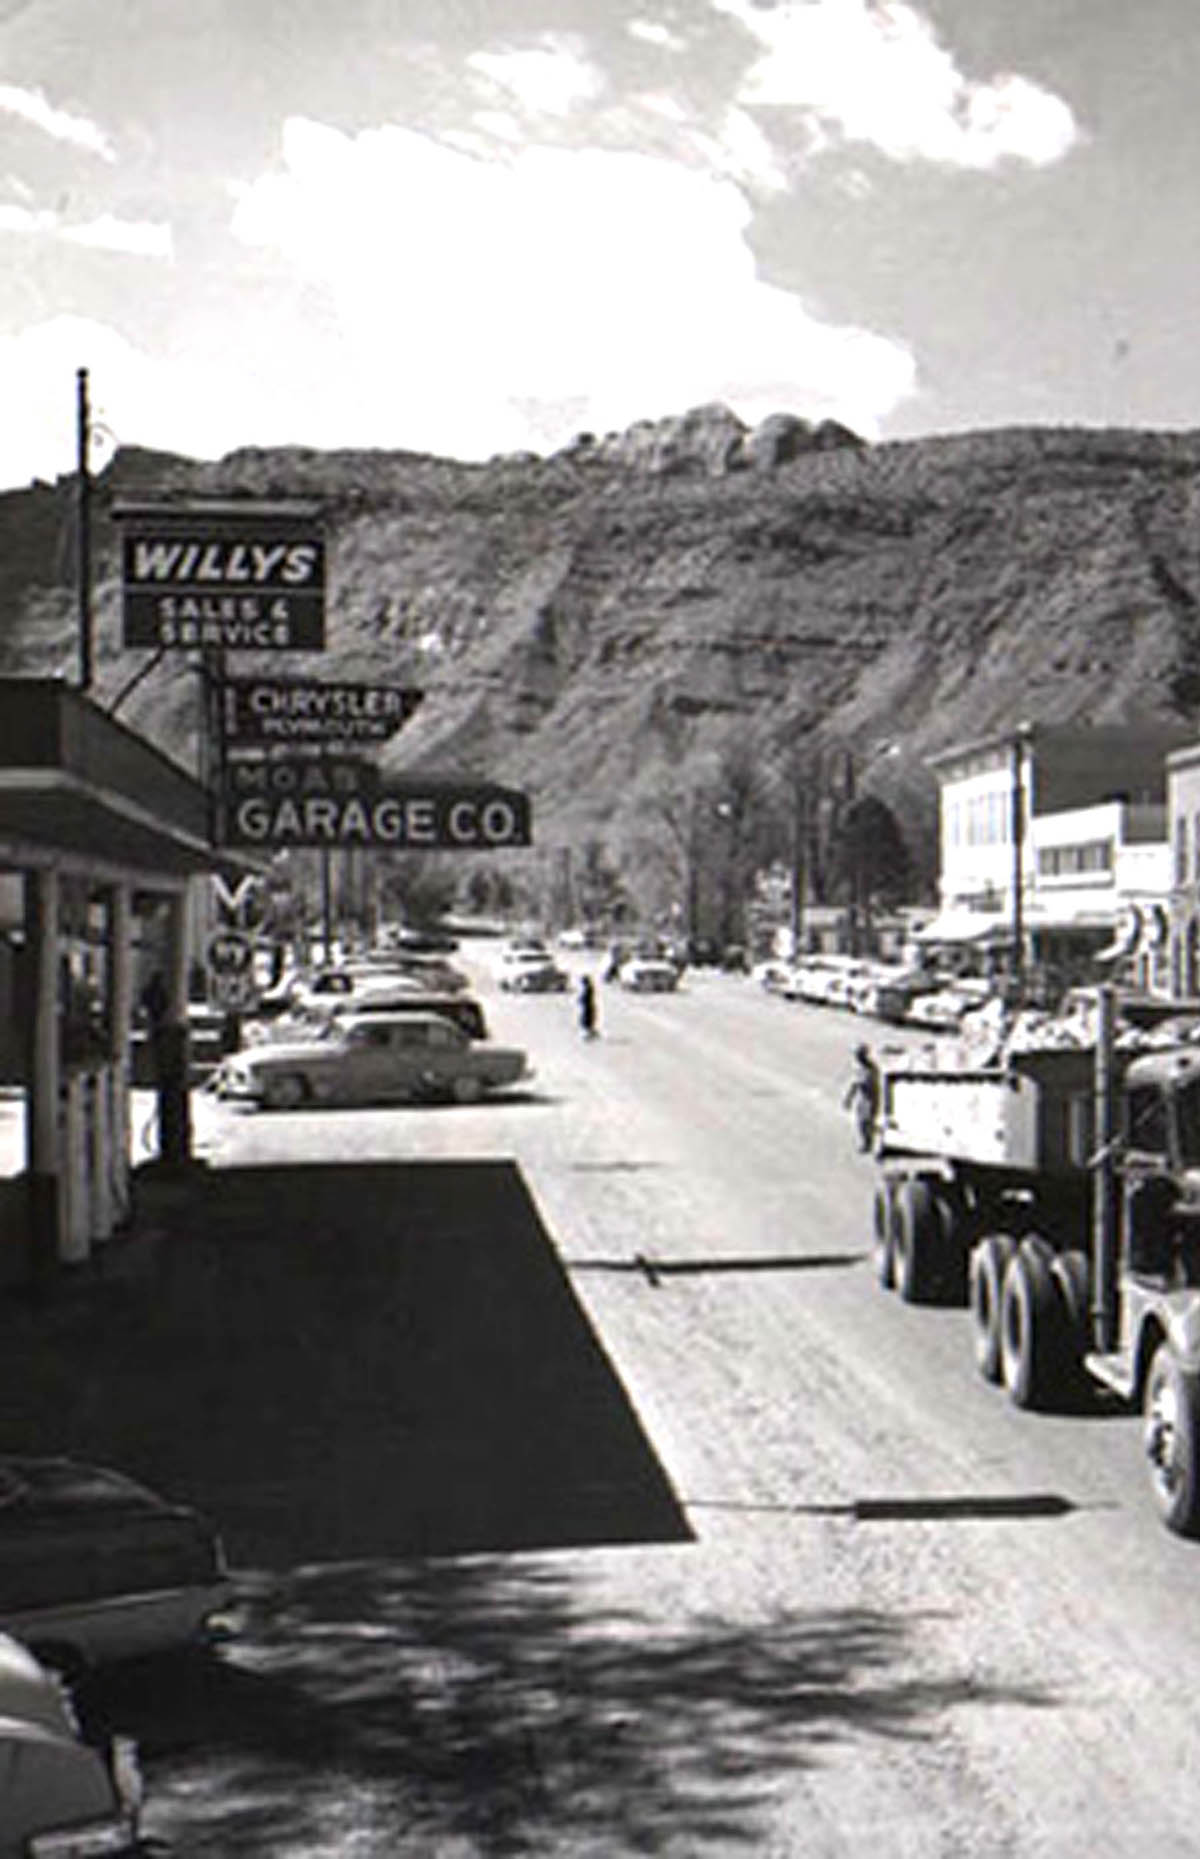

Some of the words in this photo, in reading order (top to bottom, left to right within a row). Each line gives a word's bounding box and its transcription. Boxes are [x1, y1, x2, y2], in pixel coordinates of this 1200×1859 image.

[134, 543, 316, 582] WILLYS
[159, 598, 258, 620] SALES
[160, 622, 289, 645] SERVICE
[251, 687, 401, 717] CHRYSLER
[238, 799, 437, 839] GARAGE
